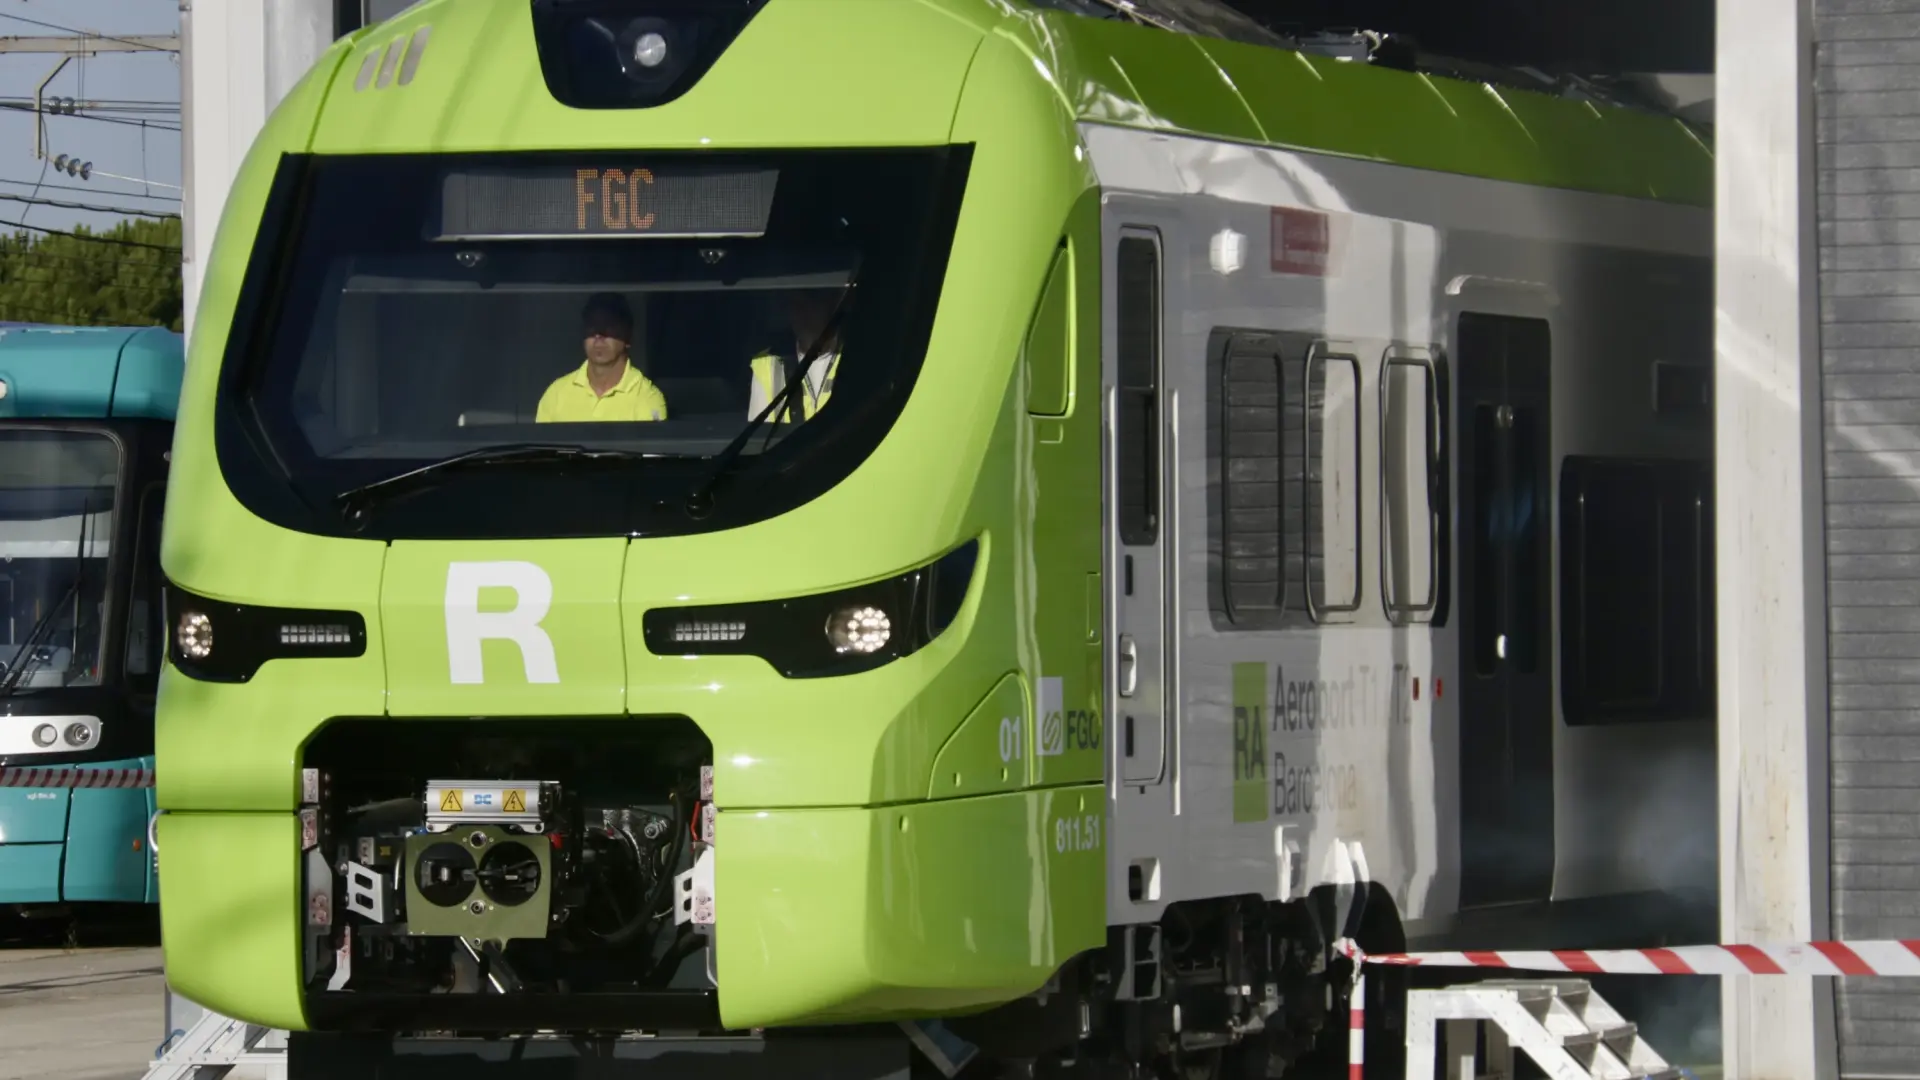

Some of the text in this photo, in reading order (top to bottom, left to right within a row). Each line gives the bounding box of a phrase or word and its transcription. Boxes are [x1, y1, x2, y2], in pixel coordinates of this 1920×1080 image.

[575, 168, 654, 229] FGC
[445, 560, 561, 684] R
[1066, 709, 1100, 750] FGC
[1272, 664, 1355, 732] Aeroport
[999, 715, 1022, 763] 01
[1233, 705, 1266, 781] RA
[1274, 751, 1357, 816] Barcelona
[1055, 814, 1101, 854] 811.51
